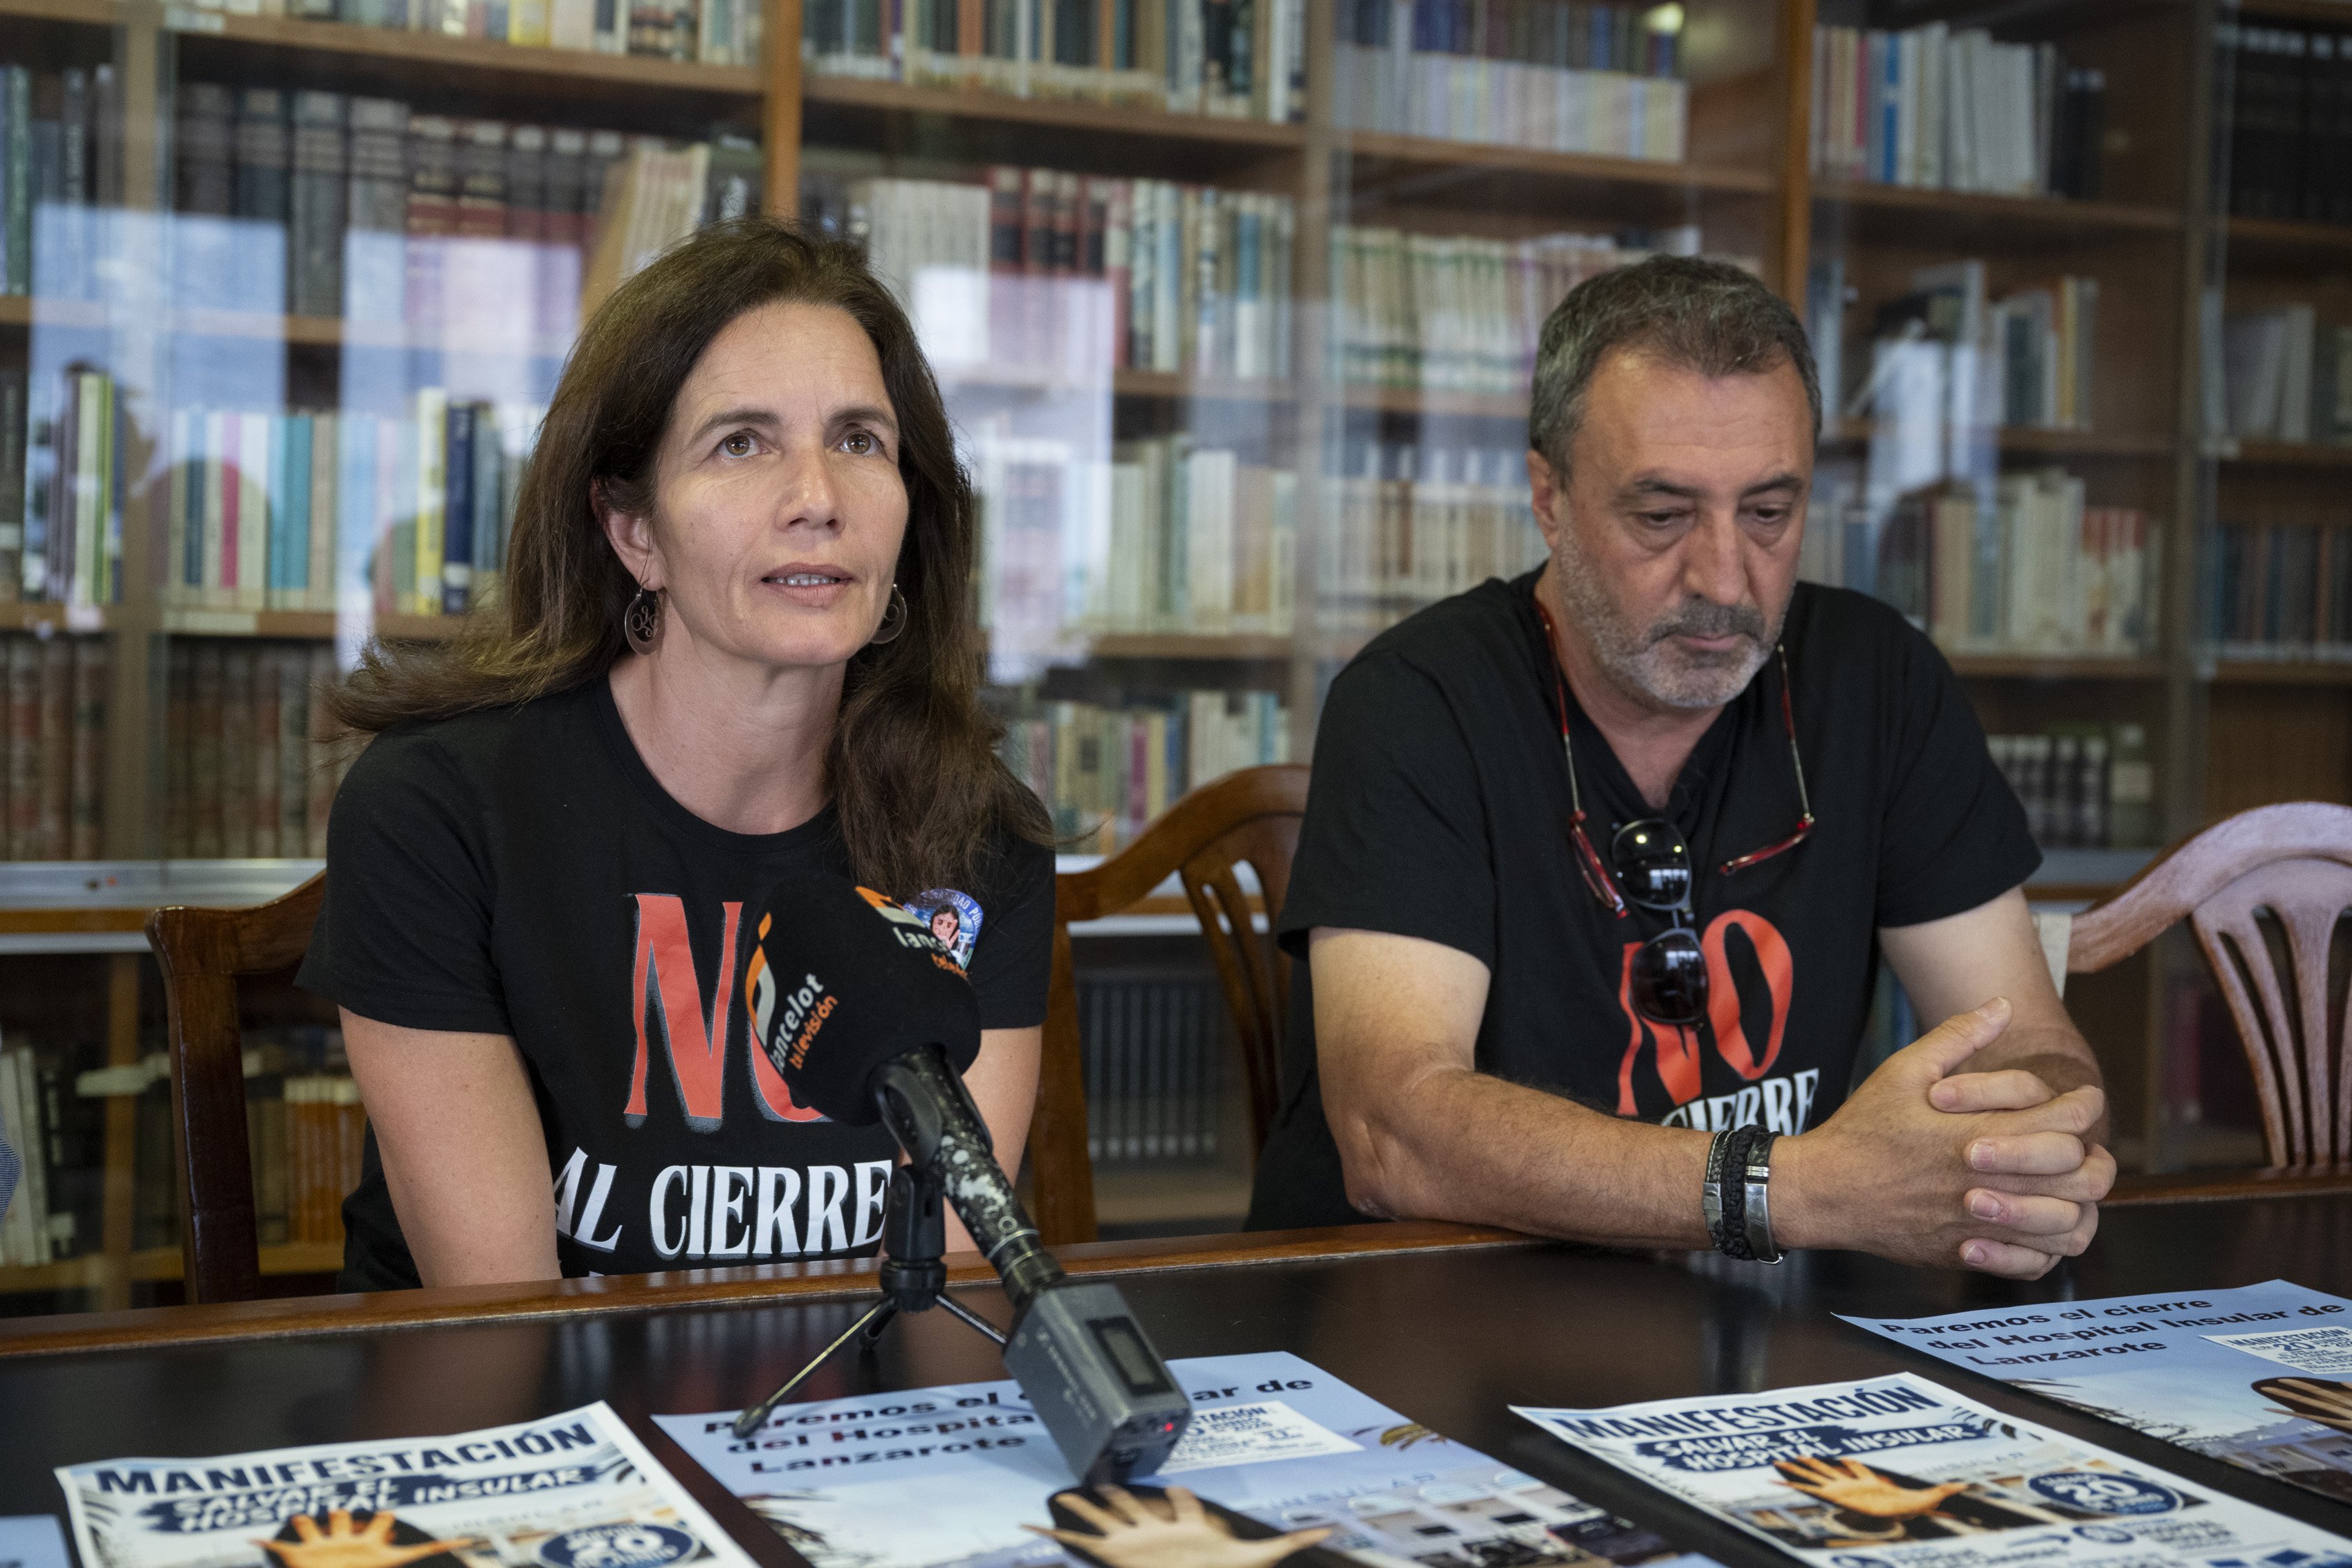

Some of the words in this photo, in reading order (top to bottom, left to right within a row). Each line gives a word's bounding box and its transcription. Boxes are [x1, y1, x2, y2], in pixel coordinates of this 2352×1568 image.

[769, 972, 825, 1075] lancelot
[1616, 908, 1794, 1116] NO
[553, 1146, 623, 1251] AL
[650, 1159, 893, 1255] CIERRE
[1879, 1313, 2051, 1335] Paremos
[2059, 1308, 2097, 1320] el
[2104, 1298, 2214, 1317] cierre
[1927, 1338, 1991, 1350] del
[1993, 1321, 2159, 1346] Hospital
[2158, 1309, 2291, 1331] Insular
[2297, 1302, 2346, 1317] de
[1965, 1340, 2167, 1366] Lanzarote
[2227, 1329, 2350, 1347] MANIFESTACIÓN
[2272, 1341, 2316, 1352] 20
[1256, 1376, 1314, 1394] de
[704, 1402, 938, 1434] Premos
[955, 1392, 999, 1409] el
[1551, 1387, 1943, 1438] MANIFESTACIÓN
[94, 1422, 597, 1494] MANIFESTACIÓN
[728, 1433, 809, 1455] del
[751, 1435, 1027, 1474] Lanzarote
[1654, 1432, 1781, 1457] SALVAR
[1779, 1429, 1821, 1446] EL
[1682, 1442, 1843, 1471] HOSPITAL
[1840, 1424, 1977, 1452] INSULAR
[415, 1468, 587, 1504] INSULAR
